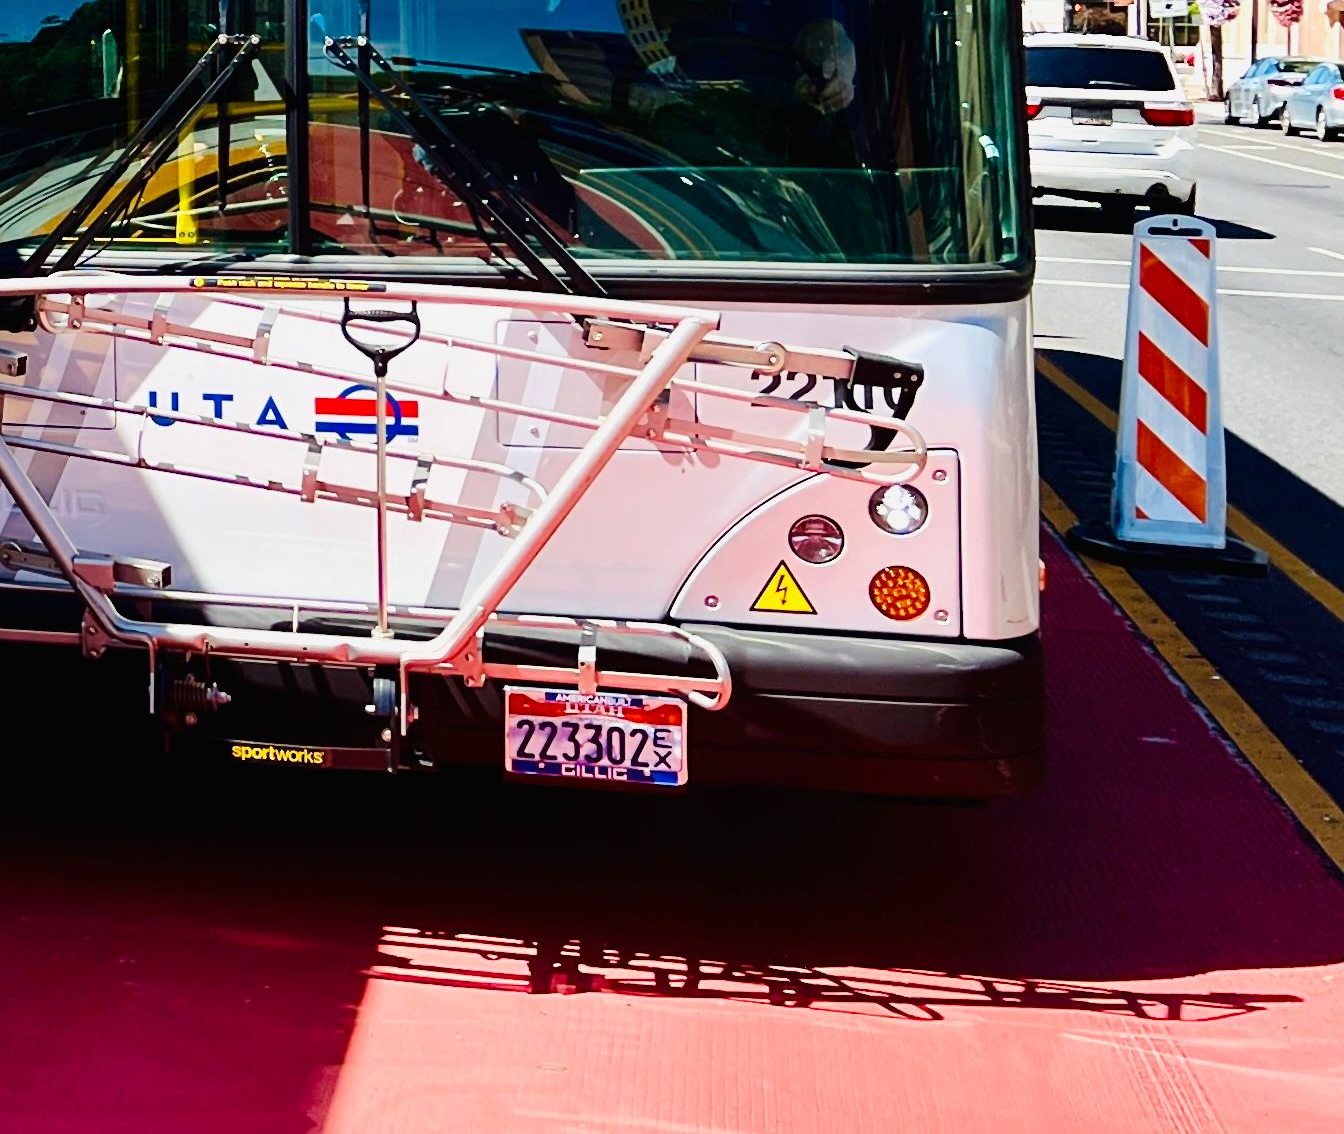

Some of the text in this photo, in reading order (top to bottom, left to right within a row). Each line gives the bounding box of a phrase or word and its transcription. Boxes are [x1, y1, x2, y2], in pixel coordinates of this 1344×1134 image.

[148, 390, 289, 430] UTA
[555, 693, 608, 706] AMERICAN
[564, 702, 625, 718] UTAH
[516, 719, 650, 768] 223302
[231, 745, 324, 764] sportworks
[561, 763, 628, 781] GILLIG
